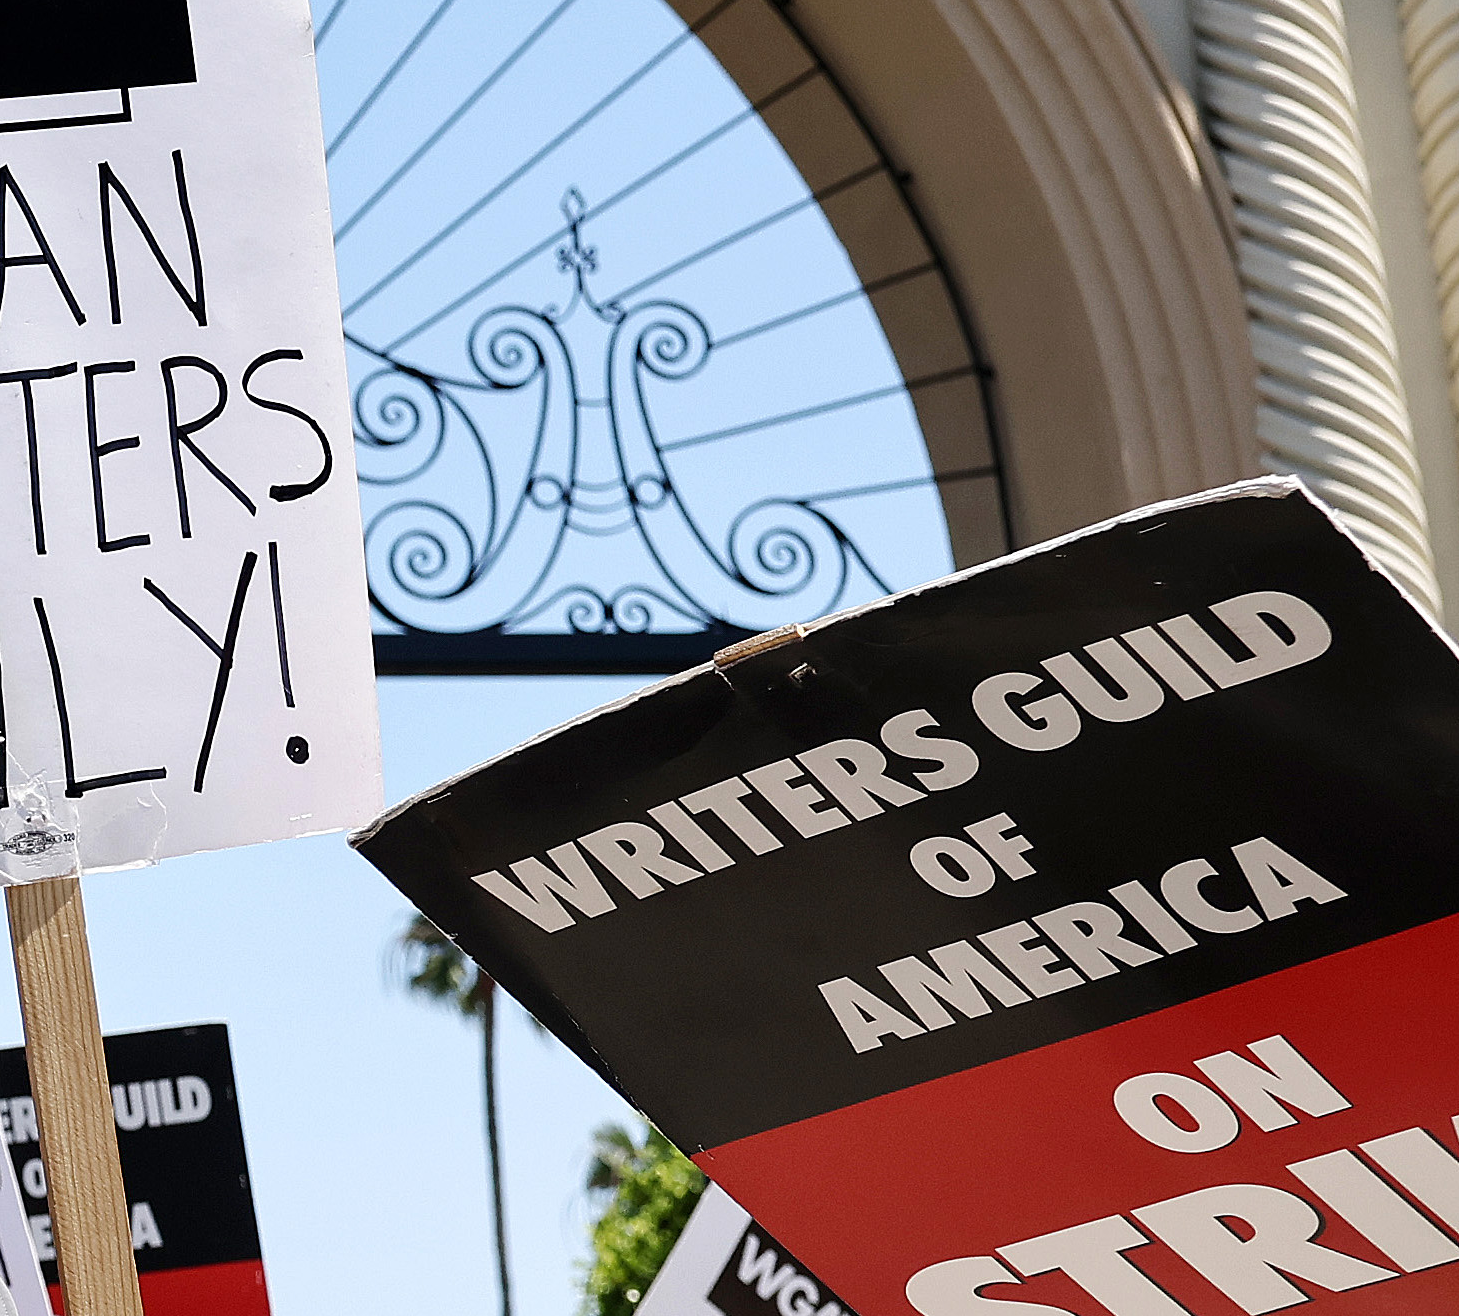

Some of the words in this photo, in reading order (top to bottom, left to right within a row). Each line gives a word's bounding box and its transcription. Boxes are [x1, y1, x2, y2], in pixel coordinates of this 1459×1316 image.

[472, 707, 980, 934] WRITERS
[972, 590, 1333, 752] GUILD
[909, 812, 1036, 898] OF
[817, 835, 1348, 1055] AMERICA
[114, 1076, 213, 1132] UILD
[1112, 1034, 1352, 1153] ON
